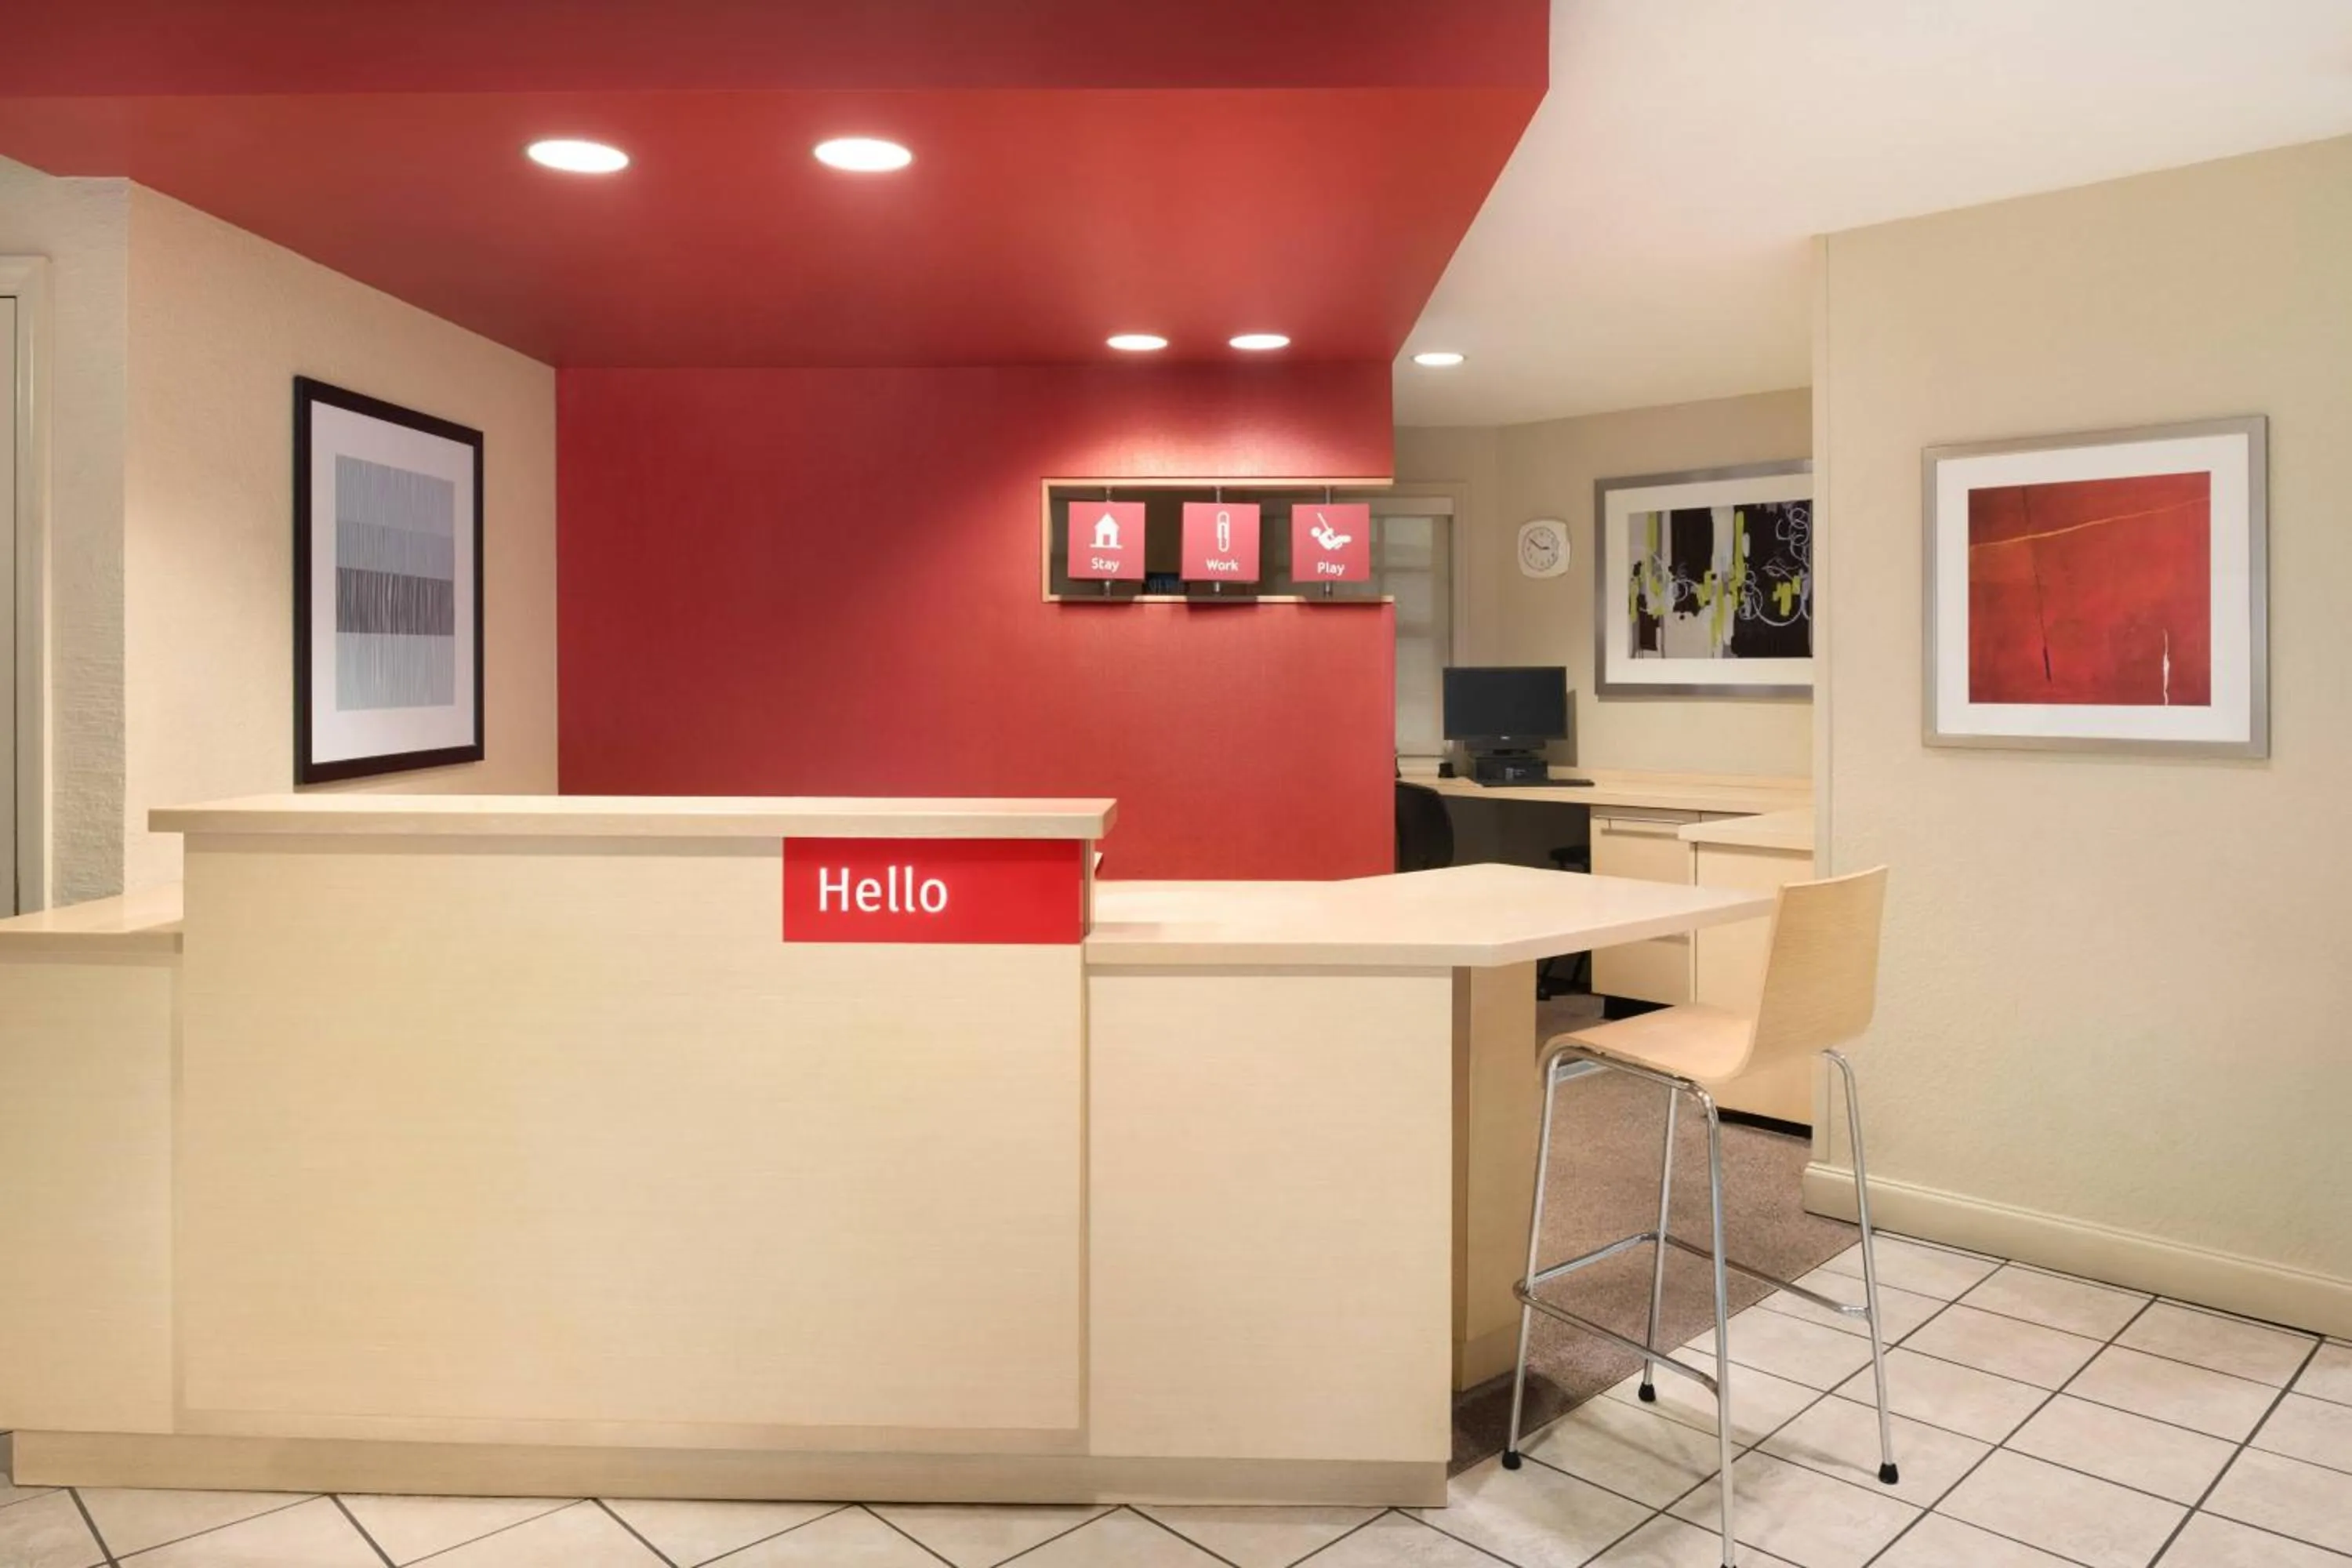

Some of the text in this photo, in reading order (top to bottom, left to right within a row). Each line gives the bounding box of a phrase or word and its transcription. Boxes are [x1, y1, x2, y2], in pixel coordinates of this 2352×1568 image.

[1091, 557, 1120, 573] Stay
[1206, 558, 1239, 572] Work
[1317, 561, 1345, 575] Play
[818, 866, 948, 913] Hello
